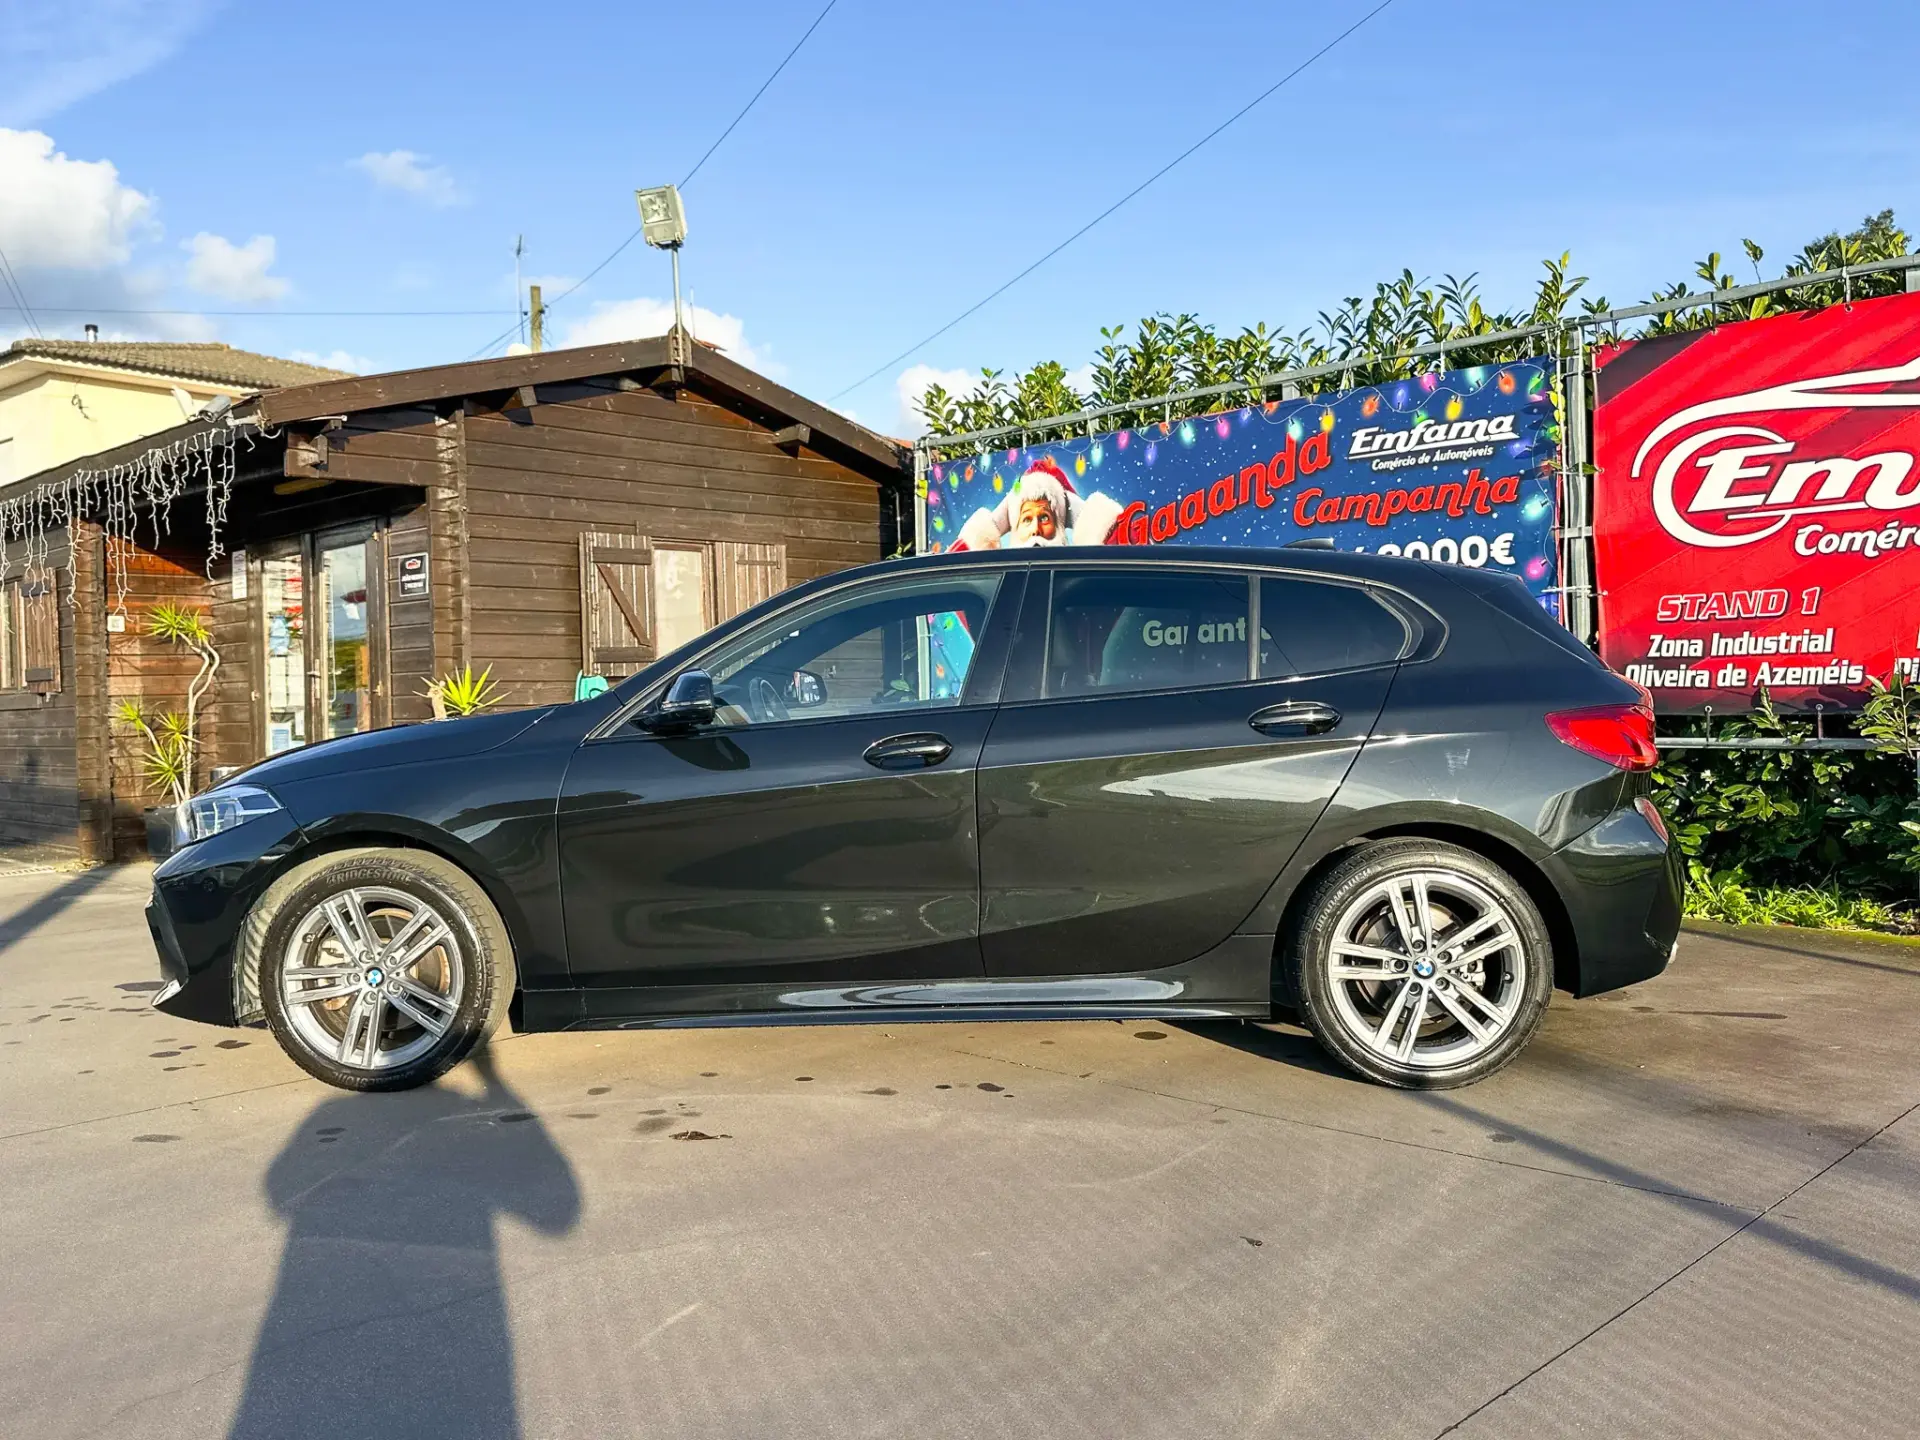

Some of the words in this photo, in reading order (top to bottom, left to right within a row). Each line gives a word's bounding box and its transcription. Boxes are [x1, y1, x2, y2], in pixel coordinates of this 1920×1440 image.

[1349, 415, 1515, 454] Emfama
[1372, 456, 1416, 471] Comércio
[1418, 453, 1431, 465] de
[1433, 446, 1493, 462] Automóveis
[1116, 431, 1331, 545] Gaaanda
[1293, 469, 1520, 526] Campanha
[1657, 589, 1788, 621] STAND
[1801, 587, 1820, 615] 1
[1647, 634, 1703, 658] Zona
[1711, 628, 1834, 657] Industrial
[1625, 664, 1710, 688] Oliveira
[1716, 663, 1747, 687] de
[1753, 659, 1864, 687] Azeméis
